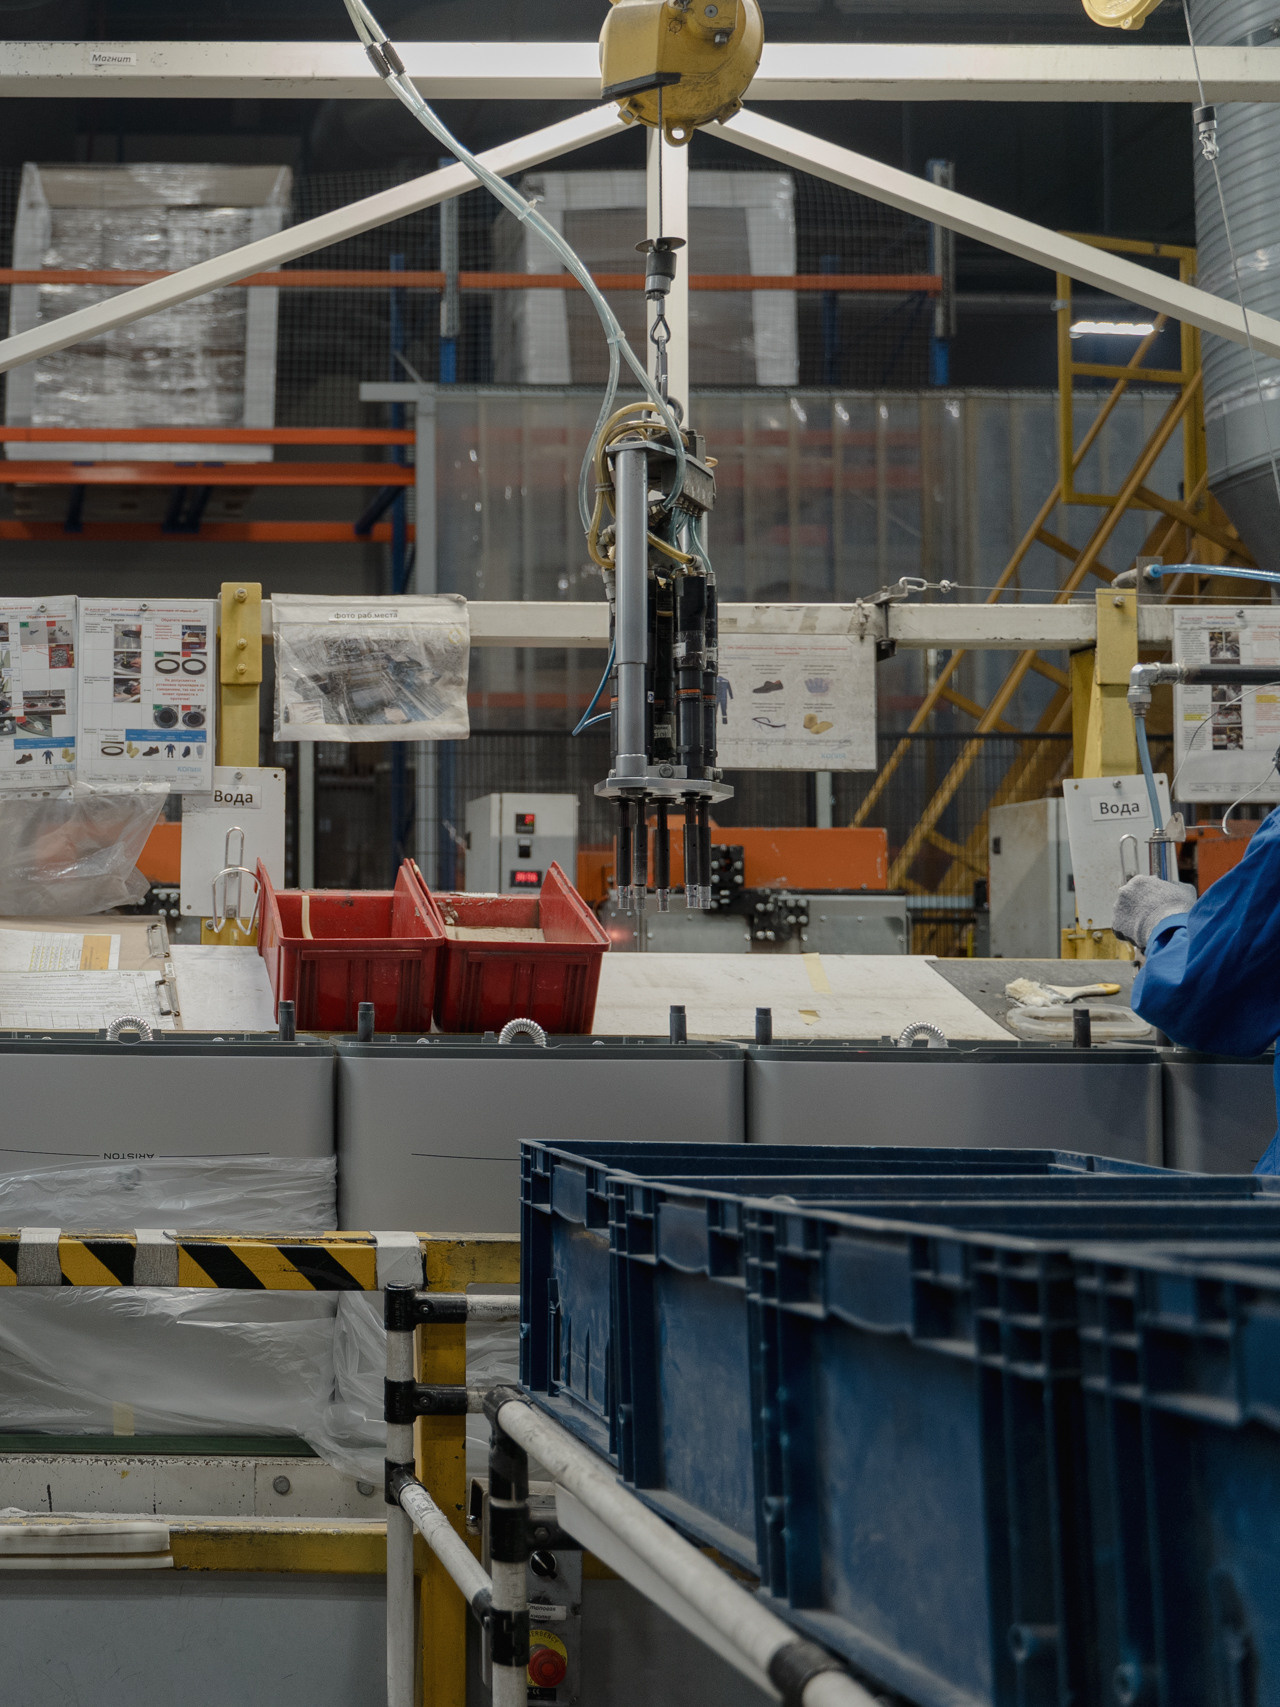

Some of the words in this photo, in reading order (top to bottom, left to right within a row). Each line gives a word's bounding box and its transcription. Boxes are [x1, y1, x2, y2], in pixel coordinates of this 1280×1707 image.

[91, 54, 132, 63] Магнит
[214, 790, 253, 806] Вода
[1100, 802, 1140, 816] Вода
[103, 1152, 155, 1160] ARISTON
[530, 1630, 560, 1644] ERGENCY
